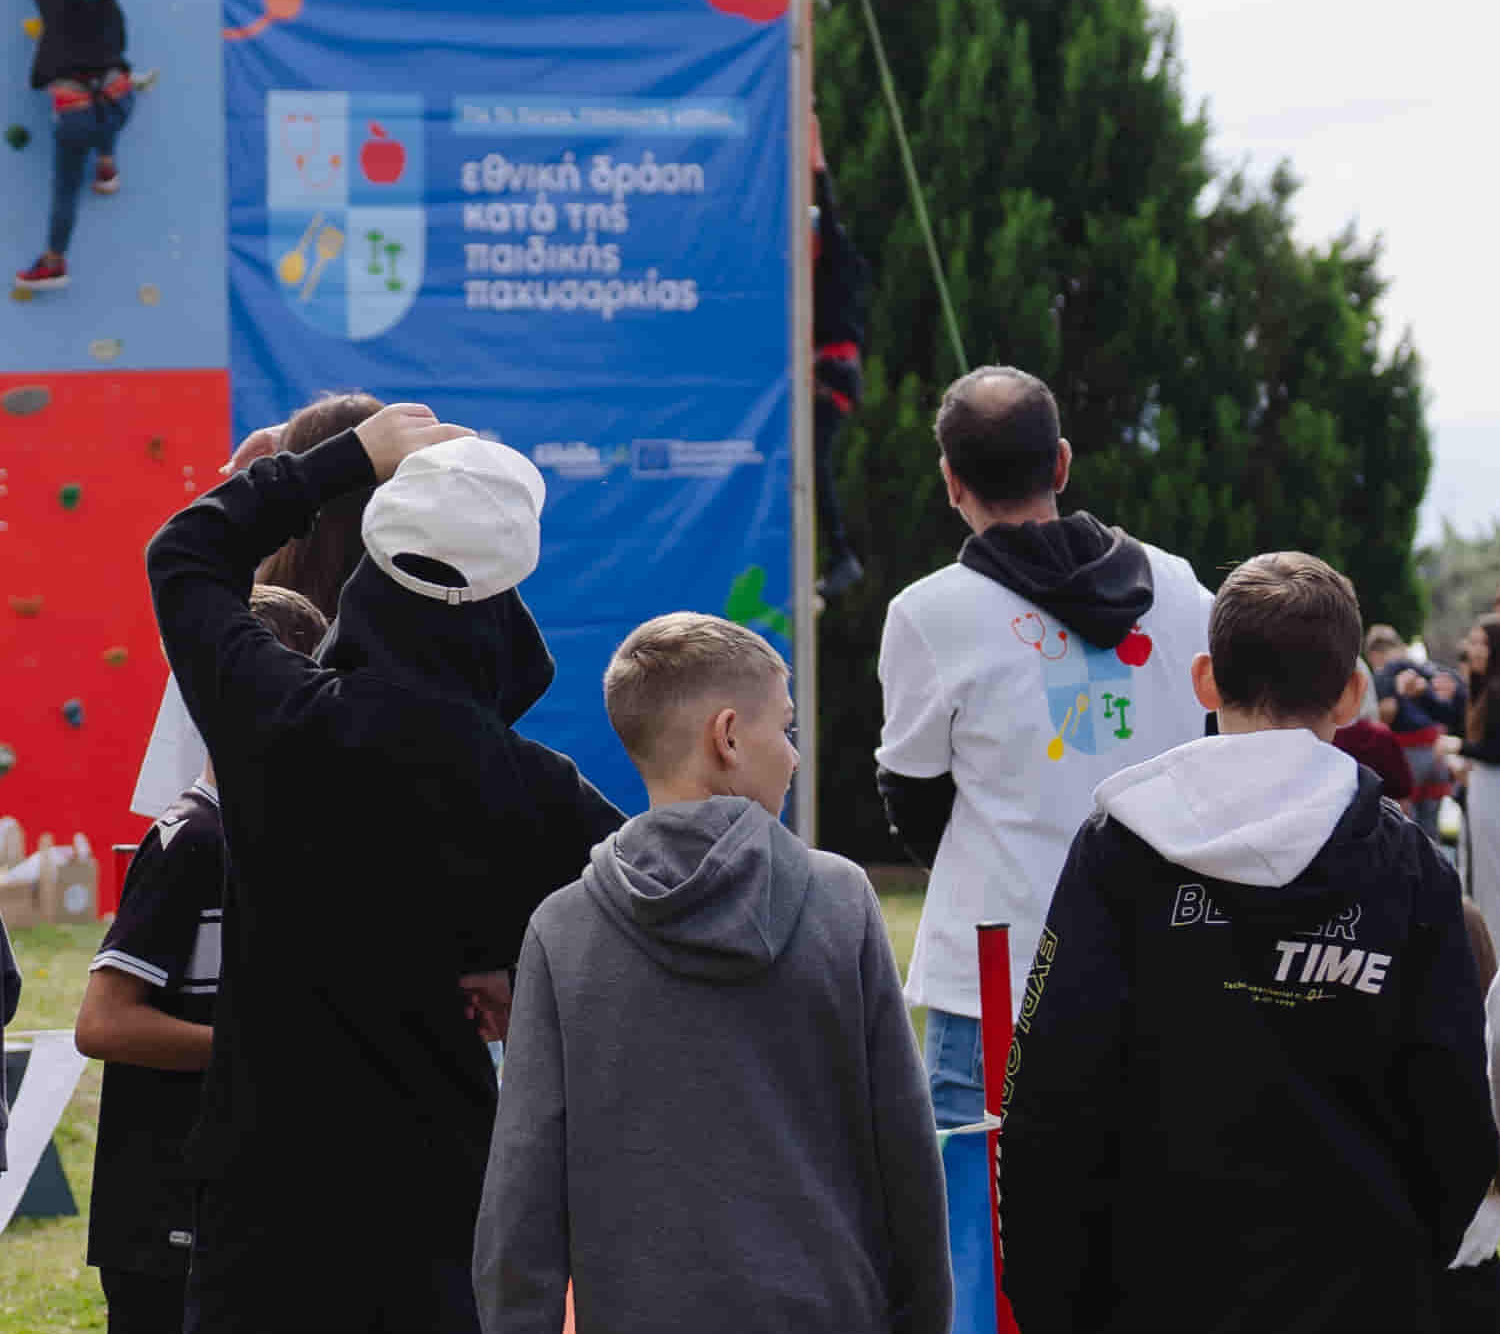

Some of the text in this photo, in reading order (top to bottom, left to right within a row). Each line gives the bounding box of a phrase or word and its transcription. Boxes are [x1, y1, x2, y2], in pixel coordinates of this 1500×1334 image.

[460, 149, 705, 204] εθνική δράση
[462, 192, 629, 234] κατά της
[463, 230, 621, 275] παιδικής
[464, 267, 700, 322] παχυσαρκίας
[1273, 938, 1393, 996] TIME
